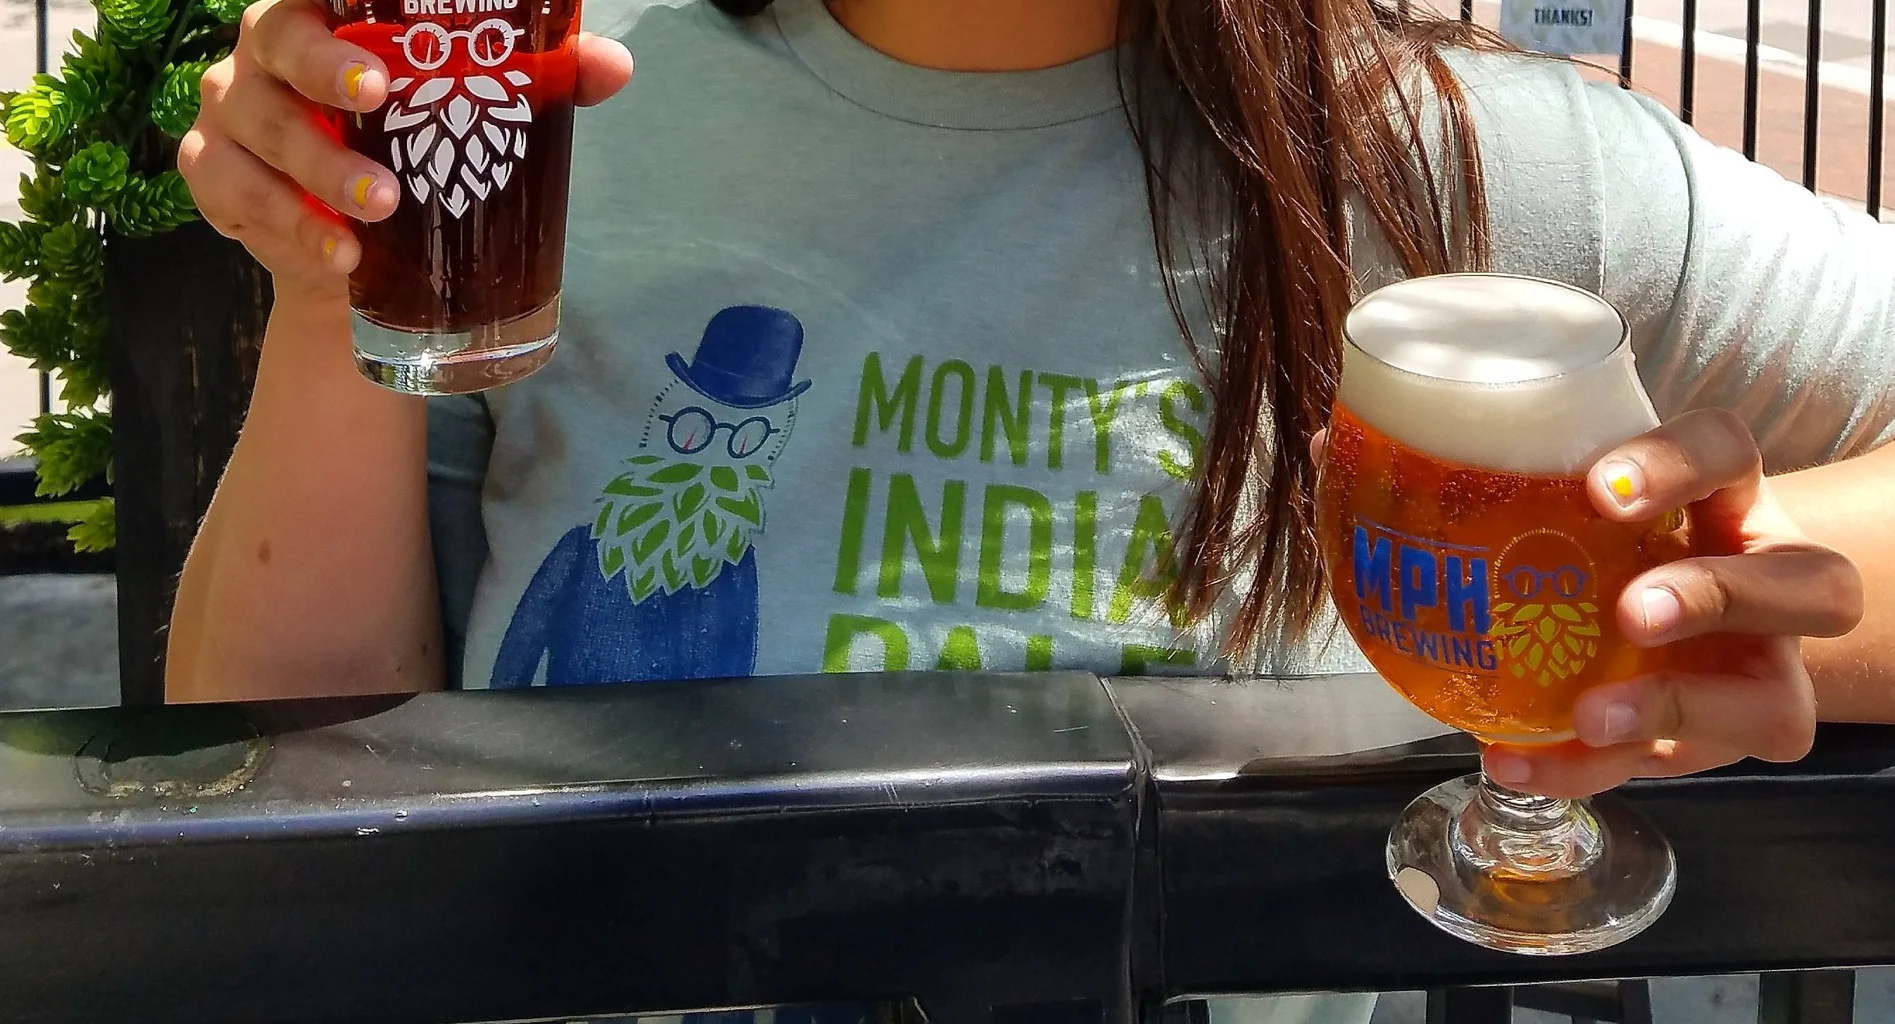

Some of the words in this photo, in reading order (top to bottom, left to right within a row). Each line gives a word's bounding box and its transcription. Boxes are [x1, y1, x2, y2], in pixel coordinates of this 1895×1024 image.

[1534, 8, 1593, 25] THANKS!
[852, 351, 1204, 479] MONTY'S
[833, 467, 1196, 628] INDIA
[1353, 525, 1490, 635] MPH
[1359, 605, 1497, 671] BREWING
